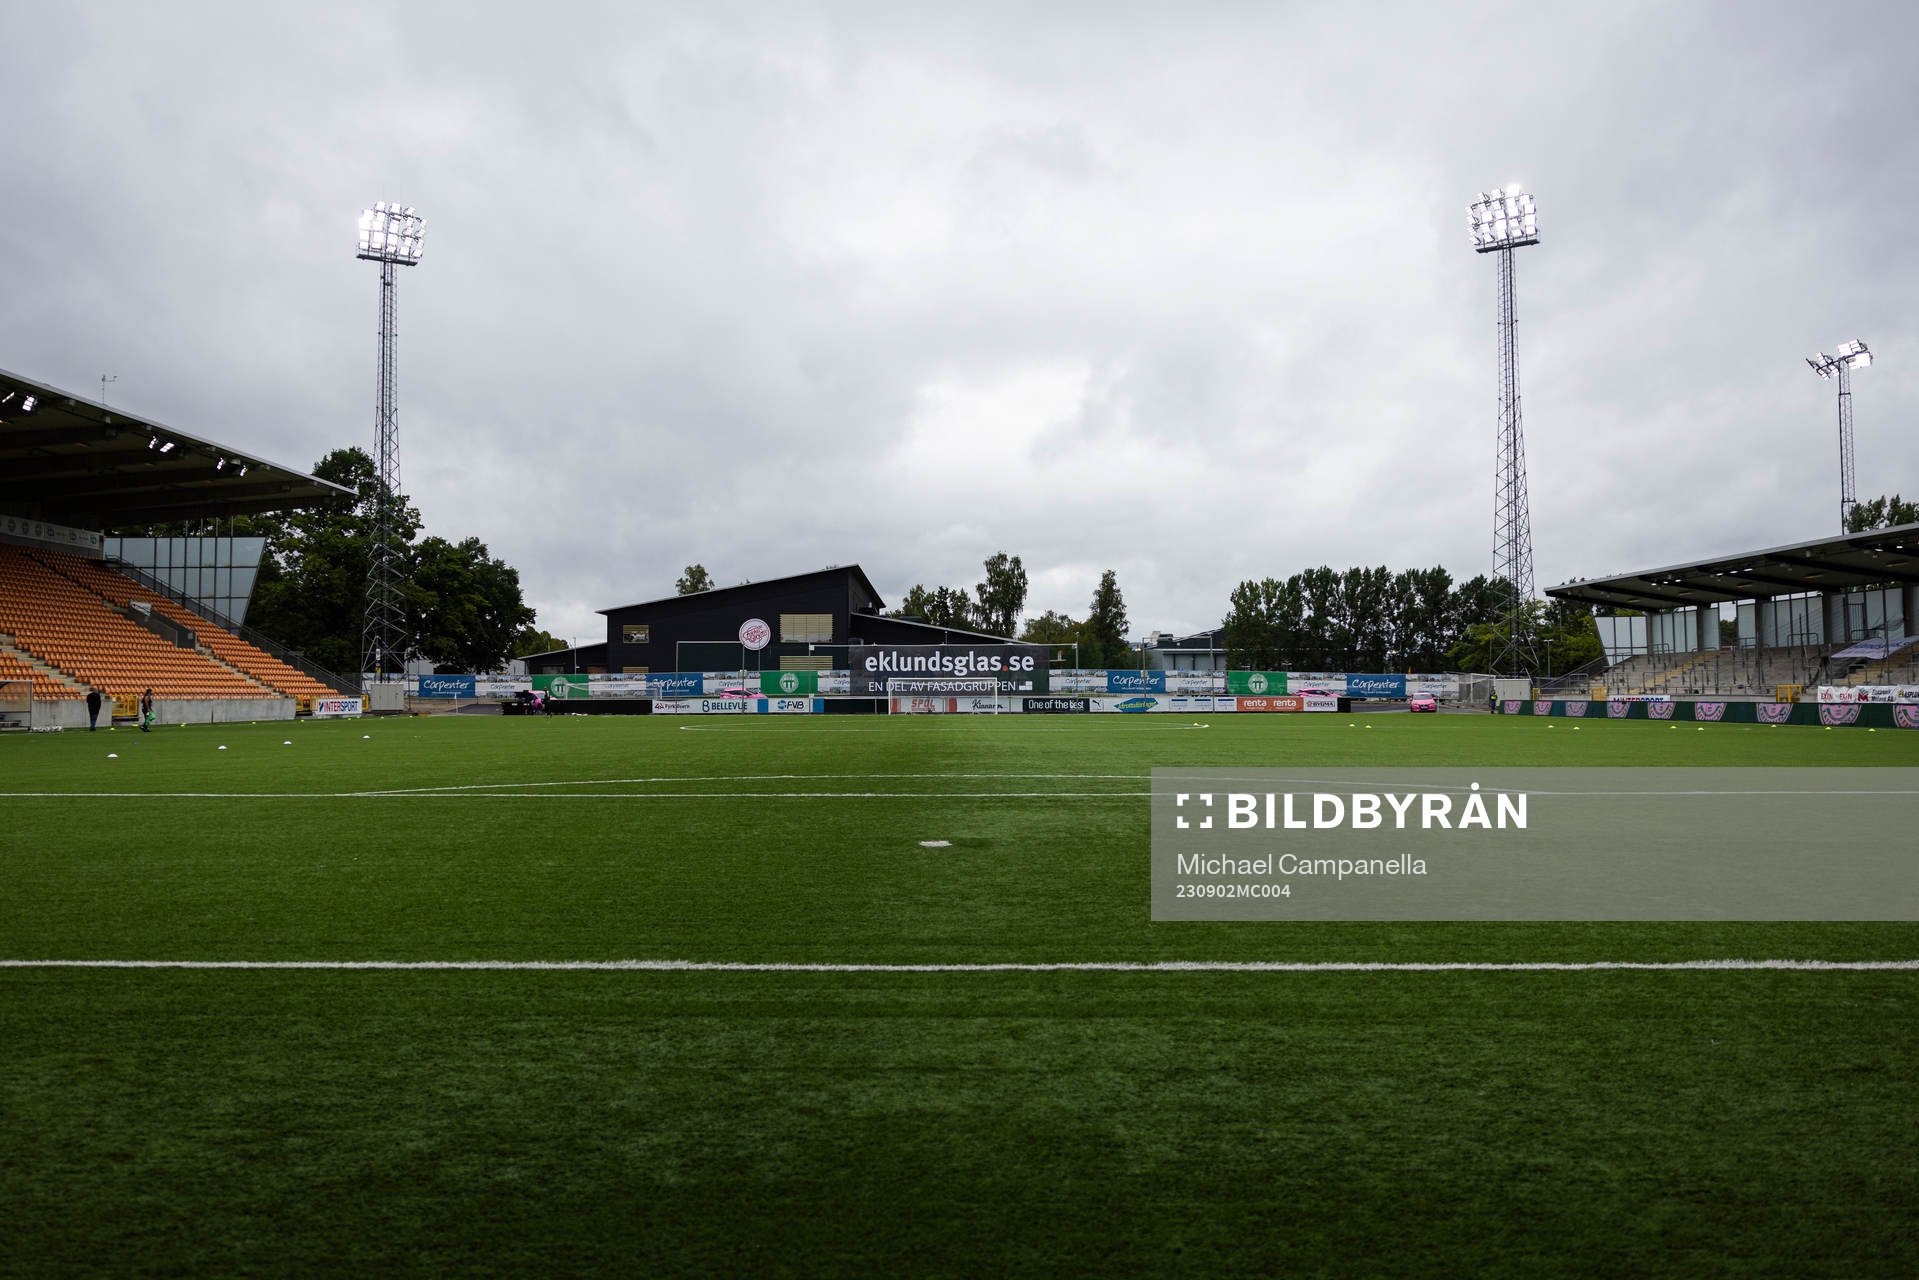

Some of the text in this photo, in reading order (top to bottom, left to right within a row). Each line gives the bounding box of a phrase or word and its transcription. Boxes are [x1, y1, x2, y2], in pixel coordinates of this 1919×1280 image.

[865, 651, 1035, 676] eklundsglas.se
[423, 679, 470, 692] Carpenter
[868, 681, 1016, 691] EN DEL AV FASADGRUPPEN
[1352, 679, 1400, 691] Carpenter
[324, 701, 358, 712] INTERSPORT
[711, 702, 748, 711] BELLEVUE
[786, 701, 805, 710] FVB
[1028, 699, 1084, 709] One of the best
[1244, 699, 1267, 707] renta
[1273, 699, 1297, 707] renta
